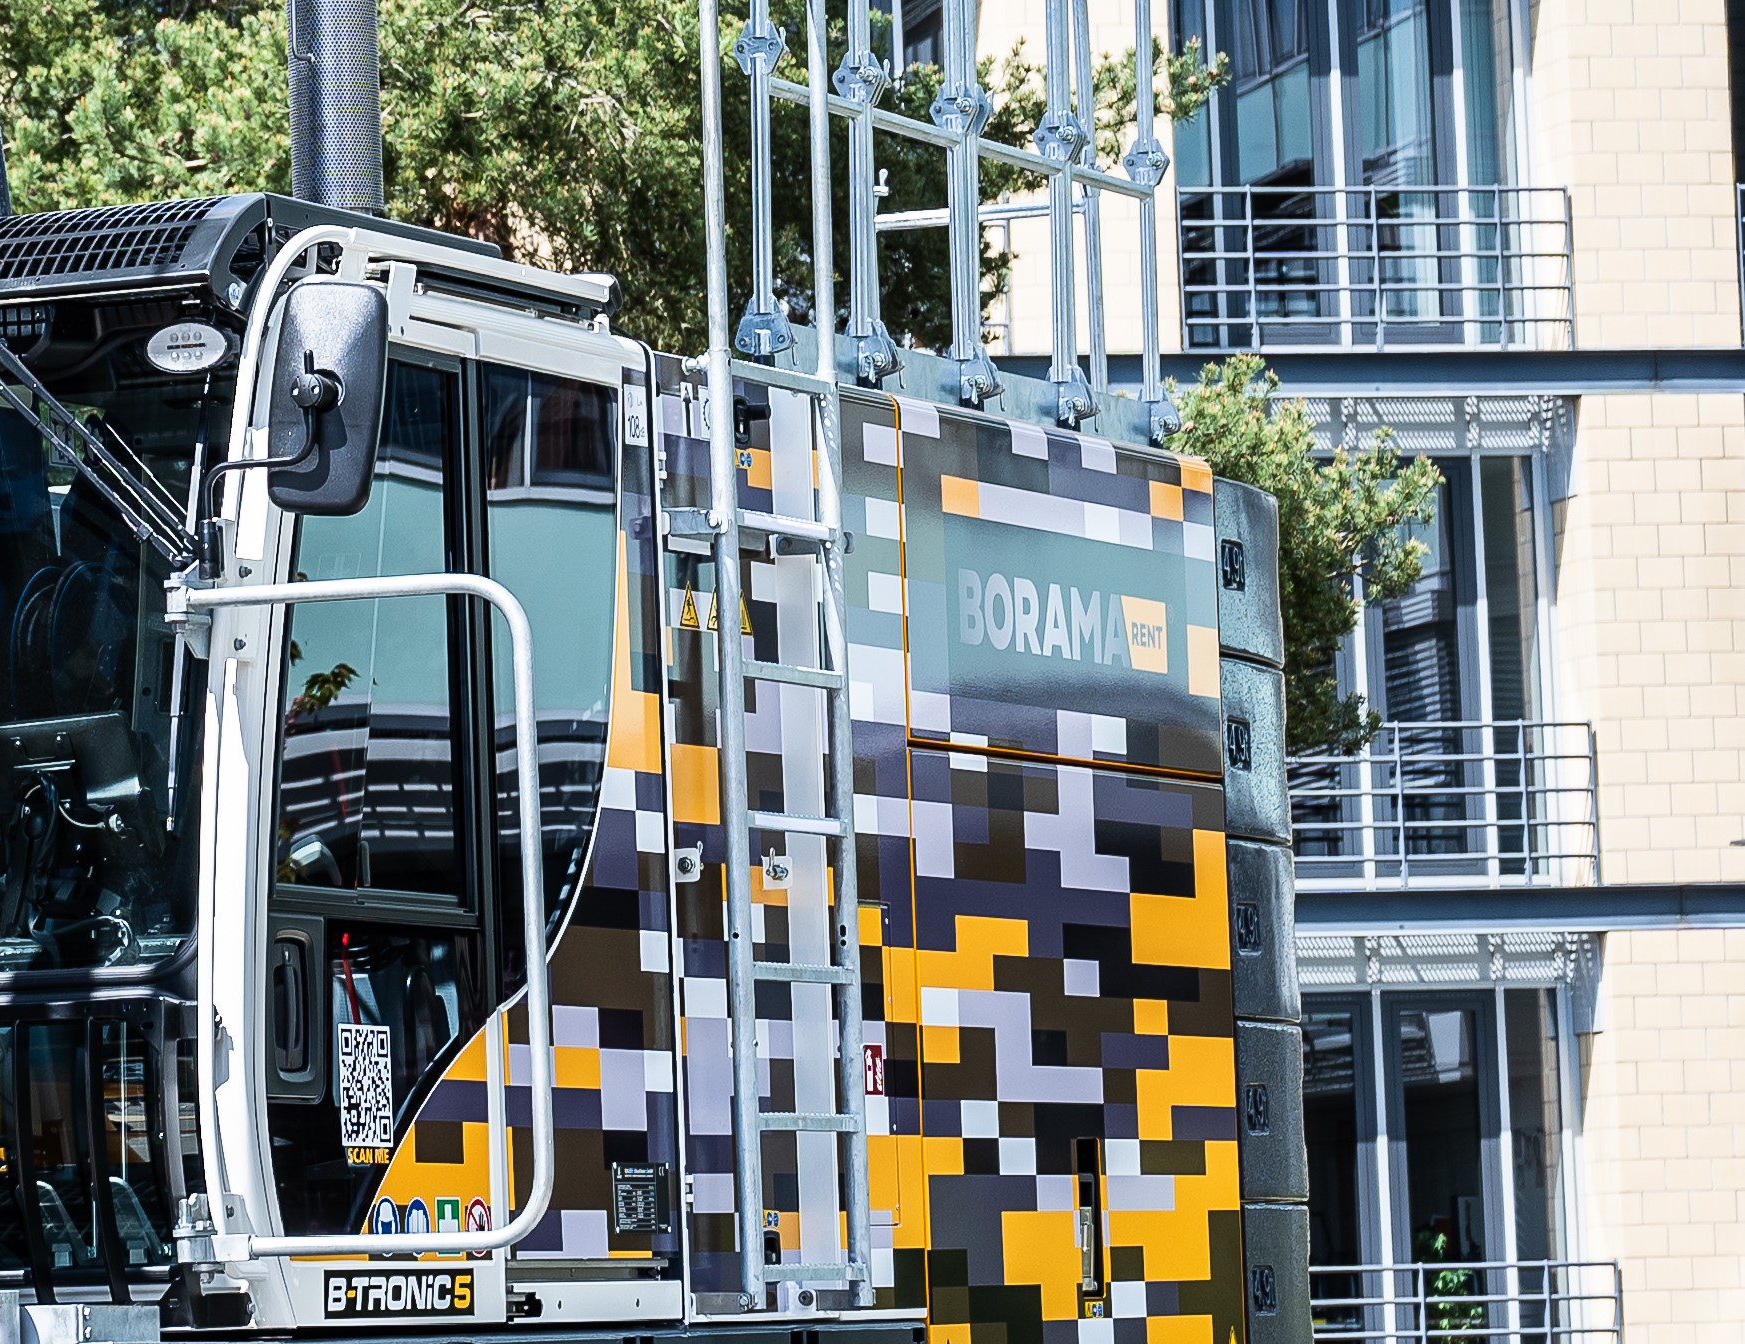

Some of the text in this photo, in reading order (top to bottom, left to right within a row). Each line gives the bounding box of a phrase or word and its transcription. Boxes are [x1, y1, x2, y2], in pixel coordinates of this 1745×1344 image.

[958, 568, 1163, 669] BORAMA RENT
[348, 1148, 390, 1164] SCAN ME
